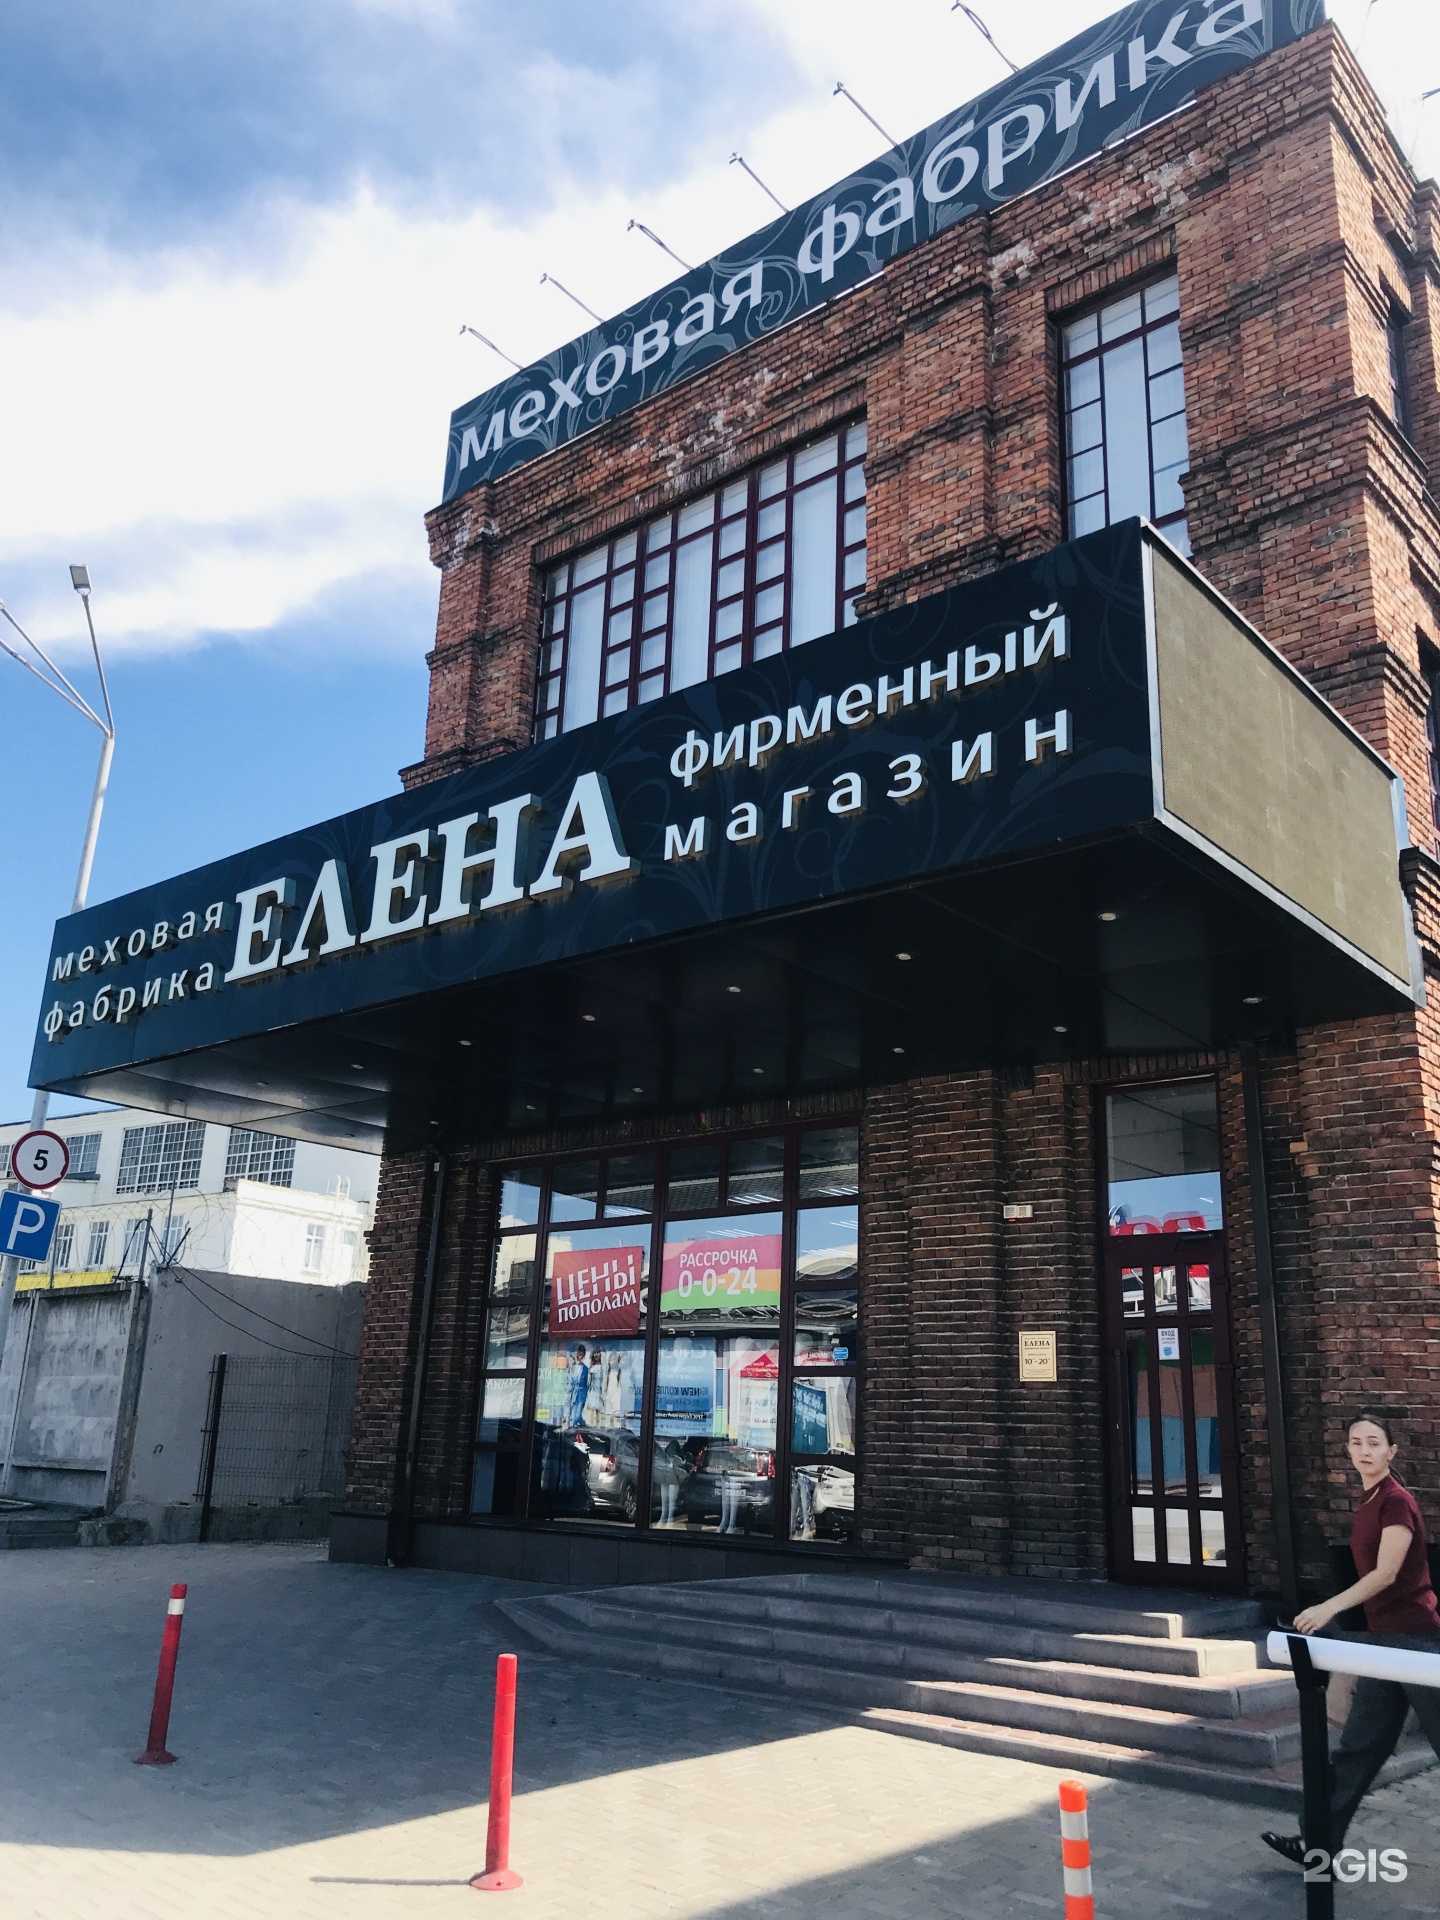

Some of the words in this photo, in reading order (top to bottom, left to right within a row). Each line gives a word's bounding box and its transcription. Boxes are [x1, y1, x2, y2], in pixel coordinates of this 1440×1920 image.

[457, 261, 765, 472] меховая
[798, 0, 1264, 282] фабрика
[669, 602, 1068, 788] фирменный
[663, 708, 1070, 861] магазин
[225, 771, 632, 983] ЕЛЕНА
[51, 901, 223, 982] меховая
[43, 961, 214, 1041] фабрика
[33, 1148, 49, 1171] 5
[6, 1200, 46, 1250] P
[679, 1248, 758, 1268] РАССРОЧКА
[556, 1254, 636, 1306] ЦЕНЫ
[557, 1289, 637, 1324] пополам
[678, 1266, 758, 1299] 0-0-24
